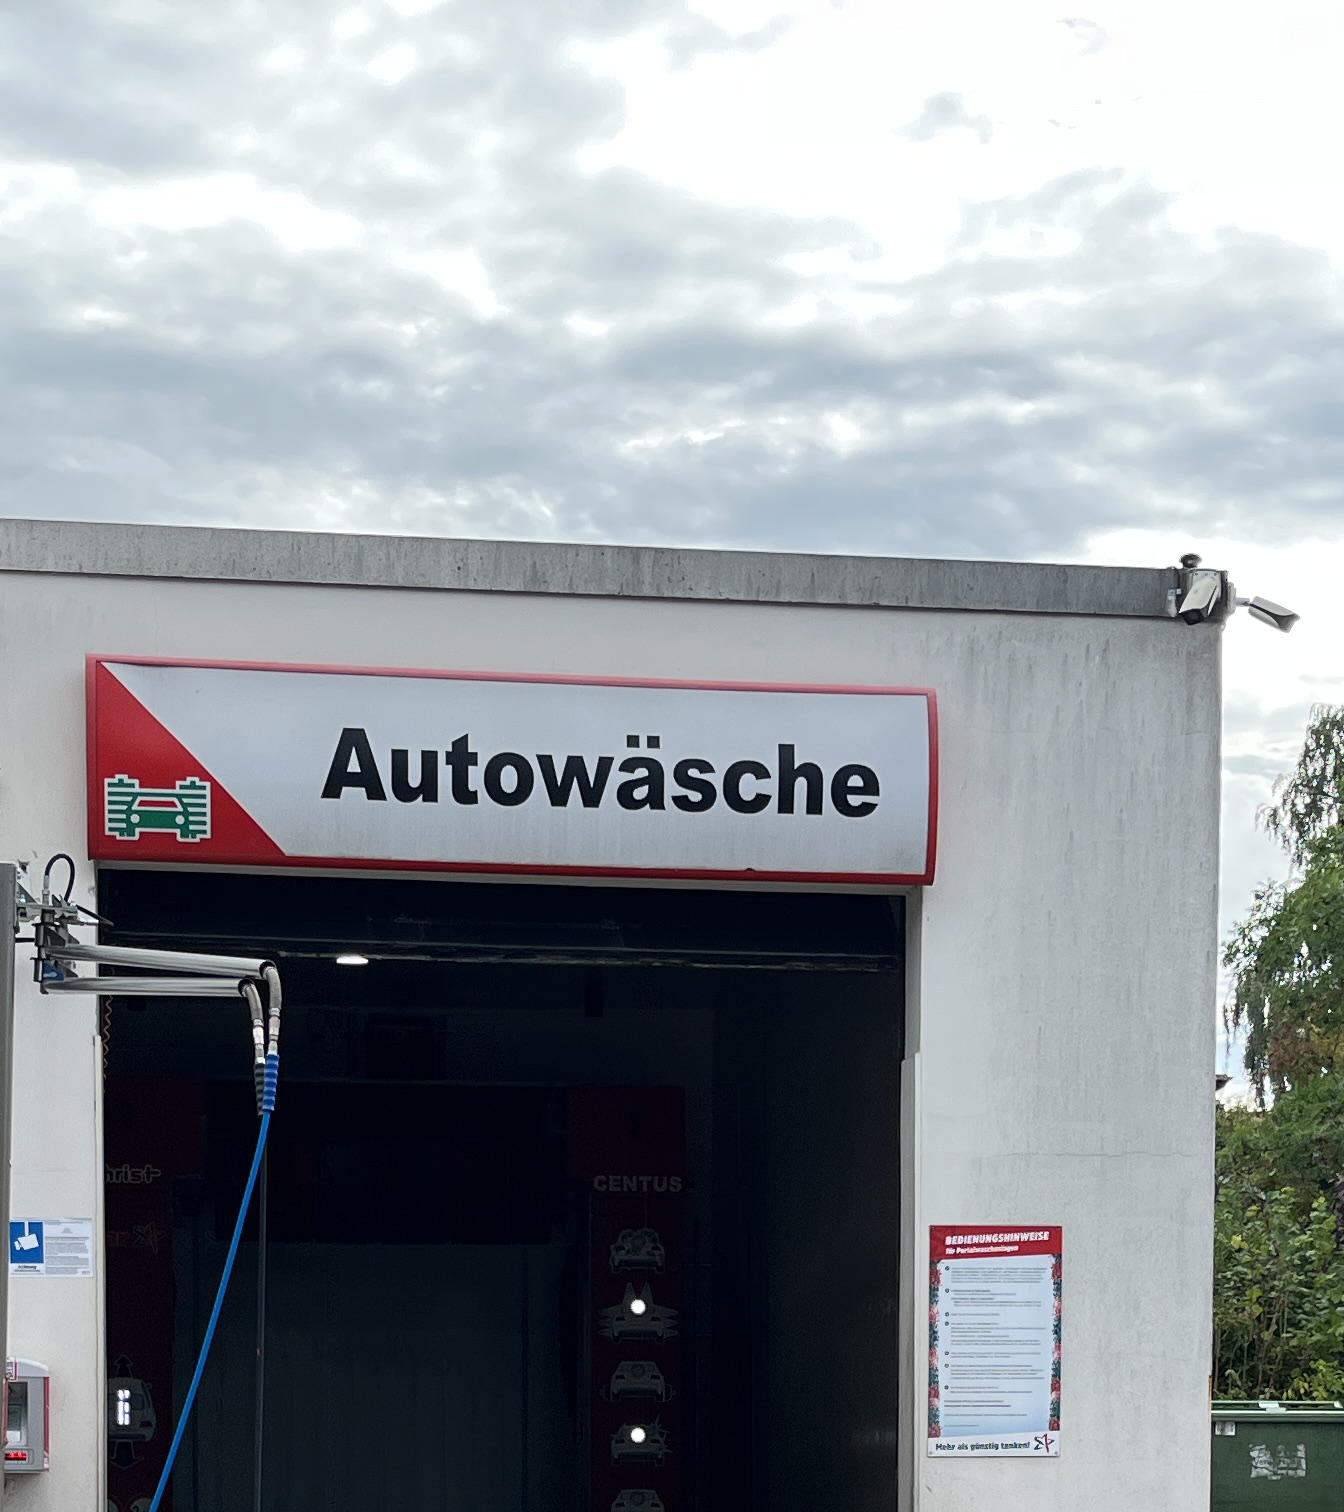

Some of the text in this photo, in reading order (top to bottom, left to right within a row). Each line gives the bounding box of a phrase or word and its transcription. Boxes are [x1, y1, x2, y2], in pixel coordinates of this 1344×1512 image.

[320, 727, 881, 818] Autowäsche
[592, 1174, 683, 1193] CENTUS
[945, 1231, 1050, 1245] BEDIENUNGSHINWEISE
[935, 1440, 1030, 1452] Mehr als günstig tanken!
